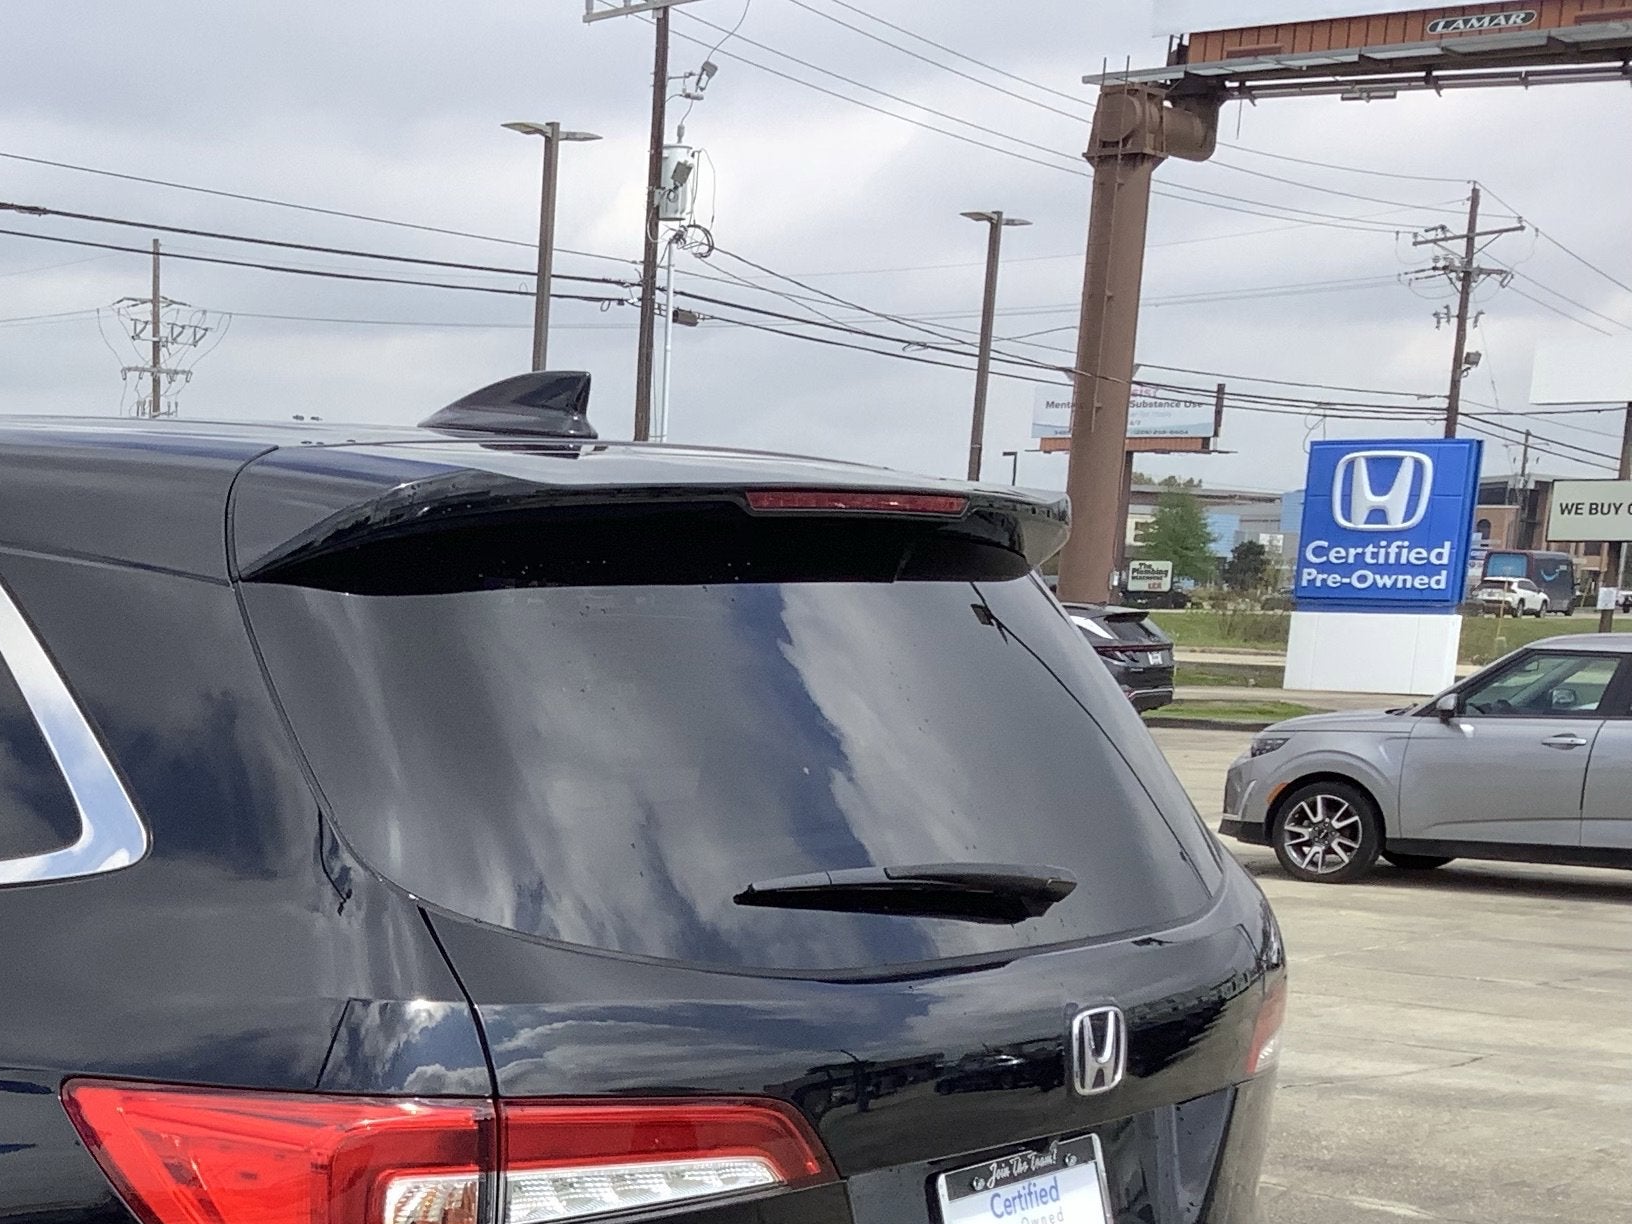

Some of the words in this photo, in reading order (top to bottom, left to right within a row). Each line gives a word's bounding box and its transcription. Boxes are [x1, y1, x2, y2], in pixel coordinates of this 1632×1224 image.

[1435, 13, 1526, 32] LAMAR
[1045, 401, 1072, 409] Ment
[1129, 400, 1181, 408] Substance
[1559, 502, 1584, 515] WE
[1589, 502, 1623, 515] BUY
[1305, 540, 1452, 565] Certified
[1301, 568, 1448, 590] Pre-Owned
[986, 1162, 1011, 1188] Join
[1011, 1156, 1029, 1177] The
[990, 1176, 1061, 1219] Certified
